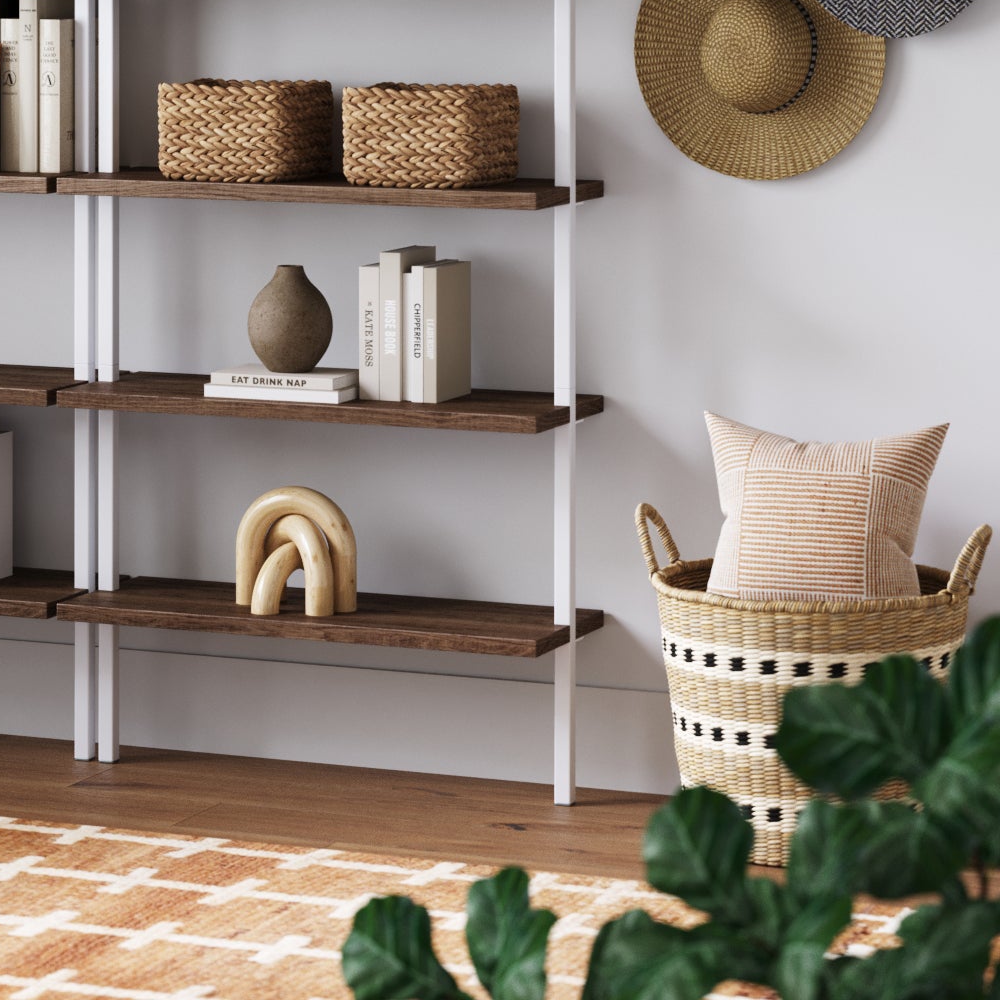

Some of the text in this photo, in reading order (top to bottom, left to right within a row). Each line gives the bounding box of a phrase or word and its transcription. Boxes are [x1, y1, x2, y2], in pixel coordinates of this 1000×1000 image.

[364, 310, 374, 336] KATE
[384, 300, 397, 356] HOUSE BOOK
[414, 303, 422, 359] CHIPPERFIELD
[364, 340, 374, 367] MOSS
[231, 376, 307, 388] EAT DRINK NAP
